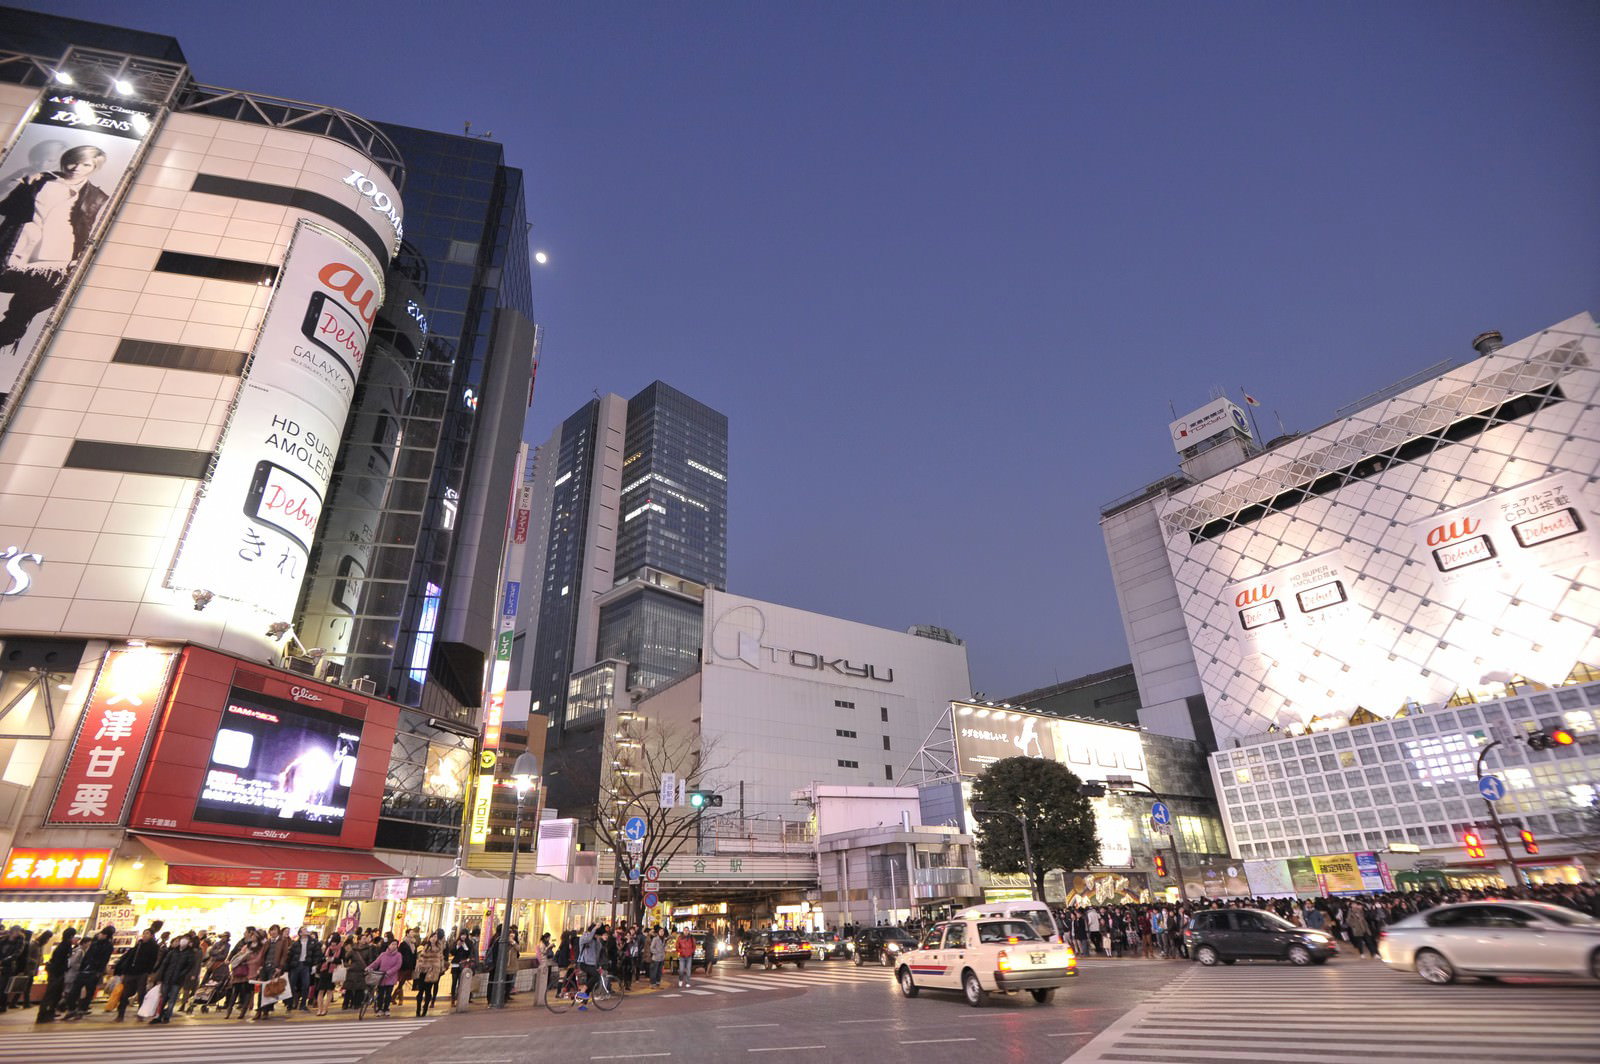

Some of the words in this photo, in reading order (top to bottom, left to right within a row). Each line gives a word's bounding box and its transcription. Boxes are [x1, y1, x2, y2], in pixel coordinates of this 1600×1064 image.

[293, 345, 341, 381] GALAXY
[271, 414, 300, 437] HD
[1500, 485, 1564, 512] デュアルコア
[1505, 494, 1571, 522] CPU搭載
[1426, 516, 1481, 547] au
[1302, 564, 1329, 578] SUPER
[1235, 583, 1275, 608] au
[500, 636, 510, 656] レイク
[760, 644, 893, 683] TOKYU
[290, 686, 323, 701] Glico
[474, 798, 488, 835] プロミス
[656, 858, 743, 873] 渋谷駅
